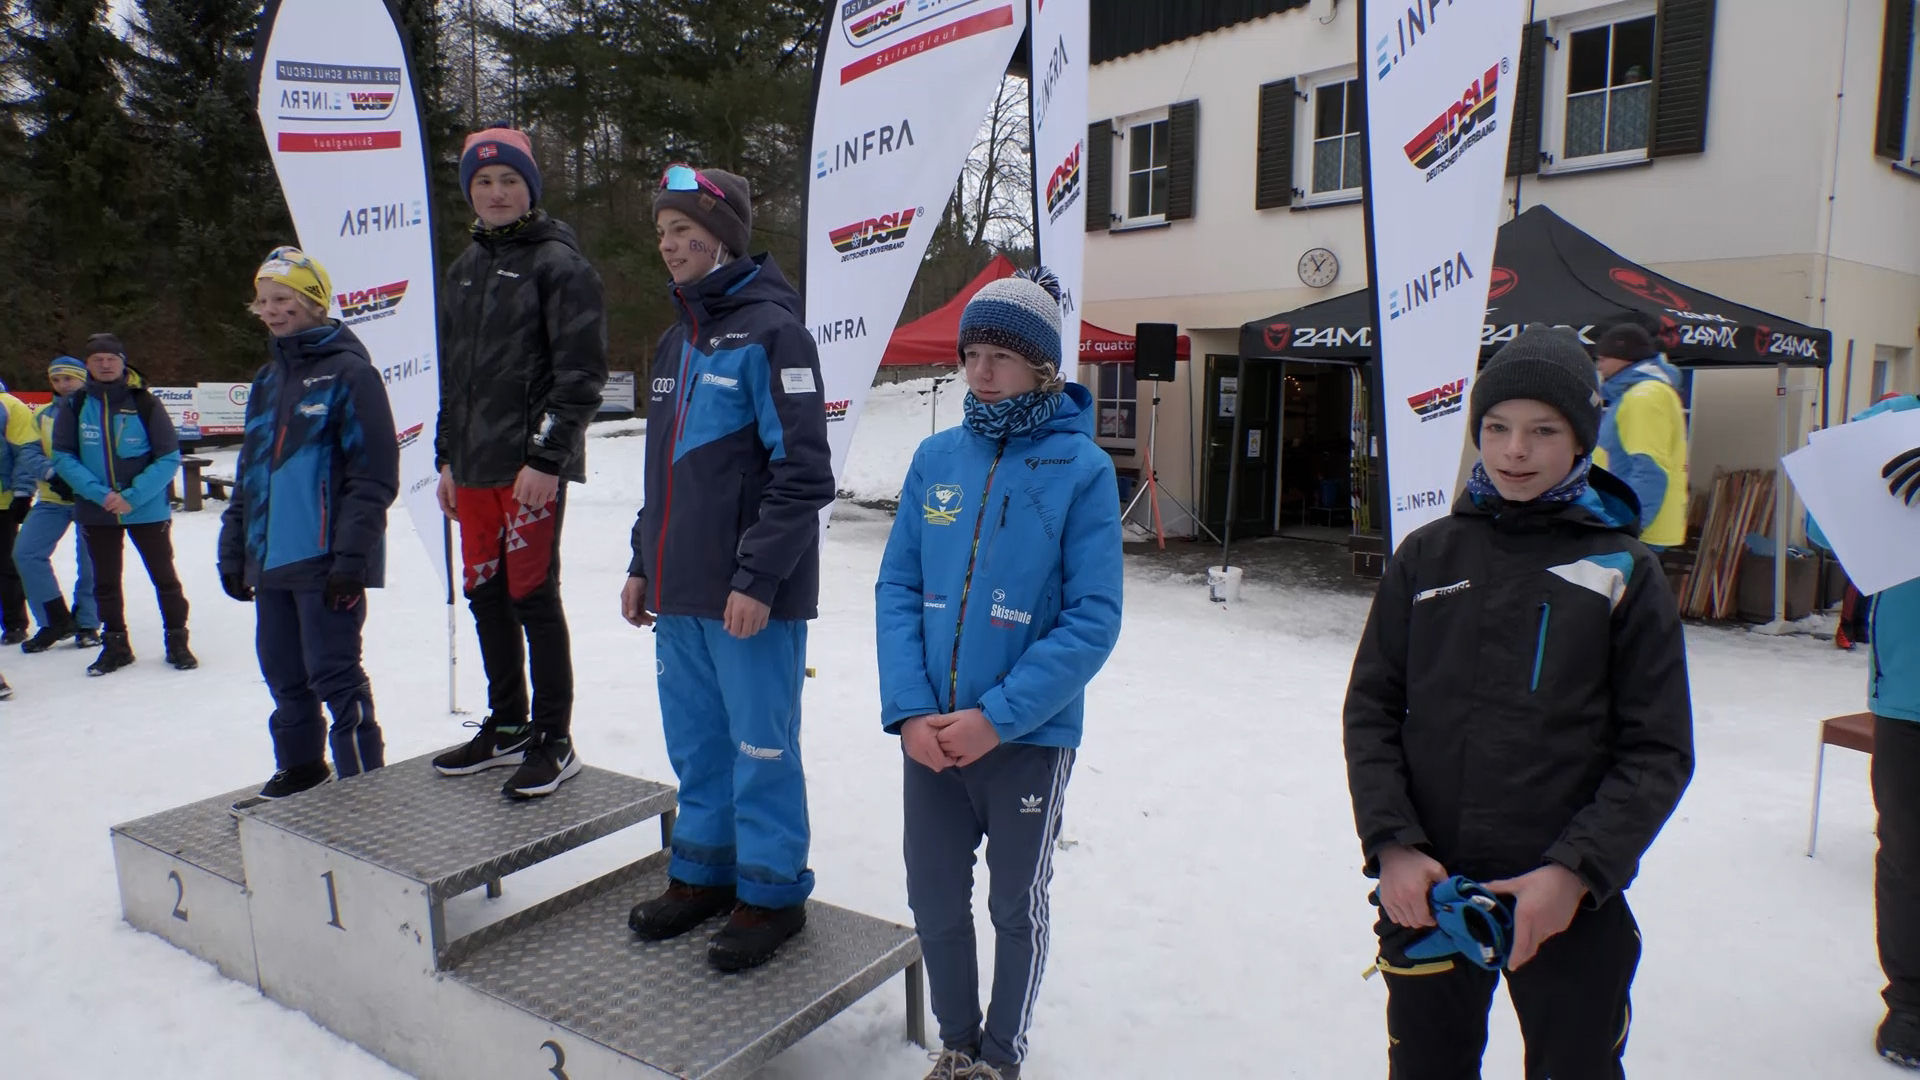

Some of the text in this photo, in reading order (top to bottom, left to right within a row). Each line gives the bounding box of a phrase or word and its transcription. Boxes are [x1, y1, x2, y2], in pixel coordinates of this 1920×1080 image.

[844, 2, 863, 17] DSV
[876, 27, 957, 66] Skilanglauf
[816, 119, 915, 179] E.INFRA
[1426, 119, 1497, 183] DEUTSCHER SKIVERBAND
[841, 241, 905, 263] DEUTSCHER SKIVERBAND
[1389, 251, 1474, 320] E.INFRA
[809, 316, 867, 345] INFRA
[1678, 325, 1739, 349] 24MX
[1079, 340, 1136, 352] of quattr
[1769, 332, 1820, 359] 24MX
[182, 410, 200, 421] 50
[1396, 489, 1446, 512] E.INFRA
[990, 603, 1032, 625] Skischule
[168, 870, 189, 922] 2
[320, 870, 347, 932] 1
[539, 1039, 570, 1080] 3
